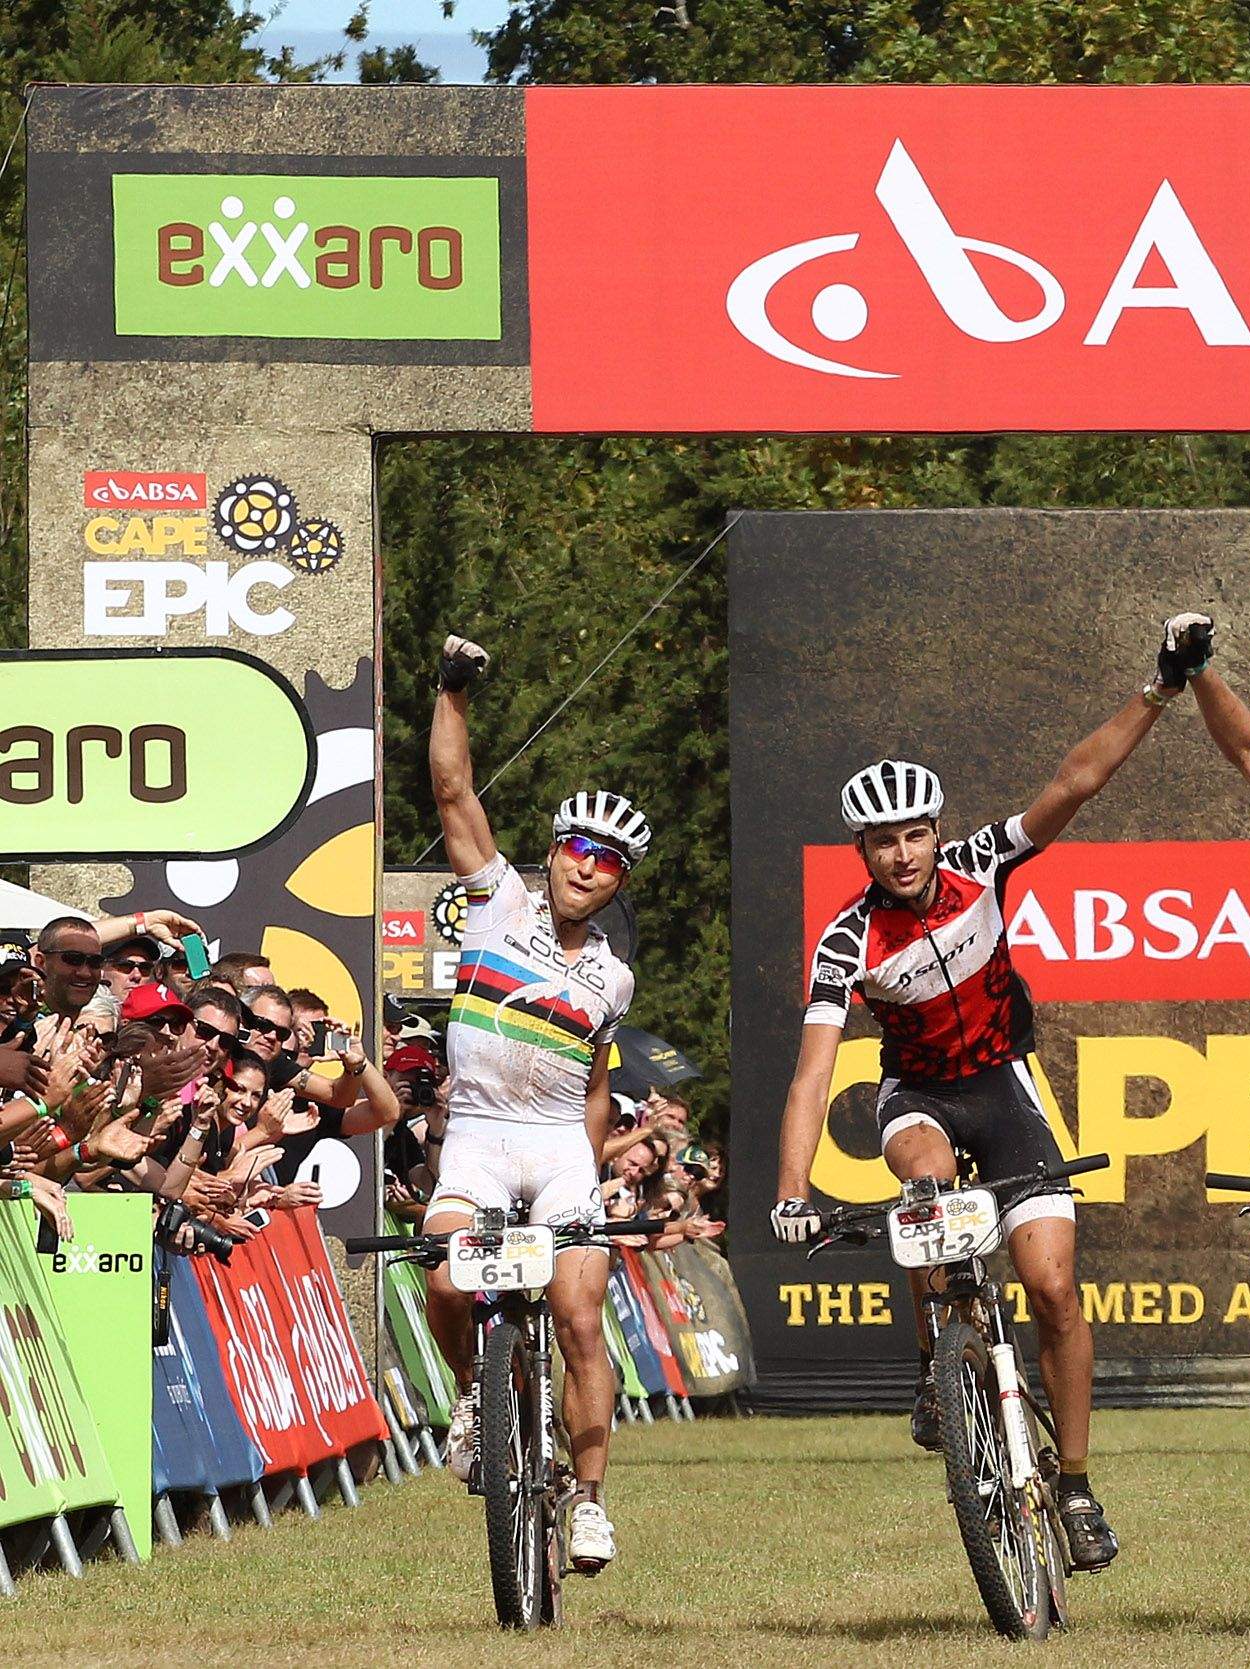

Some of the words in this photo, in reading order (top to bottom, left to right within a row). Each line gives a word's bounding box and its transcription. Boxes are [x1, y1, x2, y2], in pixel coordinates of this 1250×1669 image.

[157, 196, 463, 290] exxaro
[130, 482, 199, 502] ABSA
[84, 517, 207, 555] CAPE
[84, 561, 296, 636] EPIC
[914, 932, 978, 978] SCOTT
[53, 1245, 143, 1273] exxaro
[457, 1247, 502, 1261] CAPE
[507, 1245, 545, 1258] EPIC
[919, 1233, 975, 1262] 11-2
[481, 1263, 524, 1285] 6-1
[780, 1283, 893, 1325] THE
